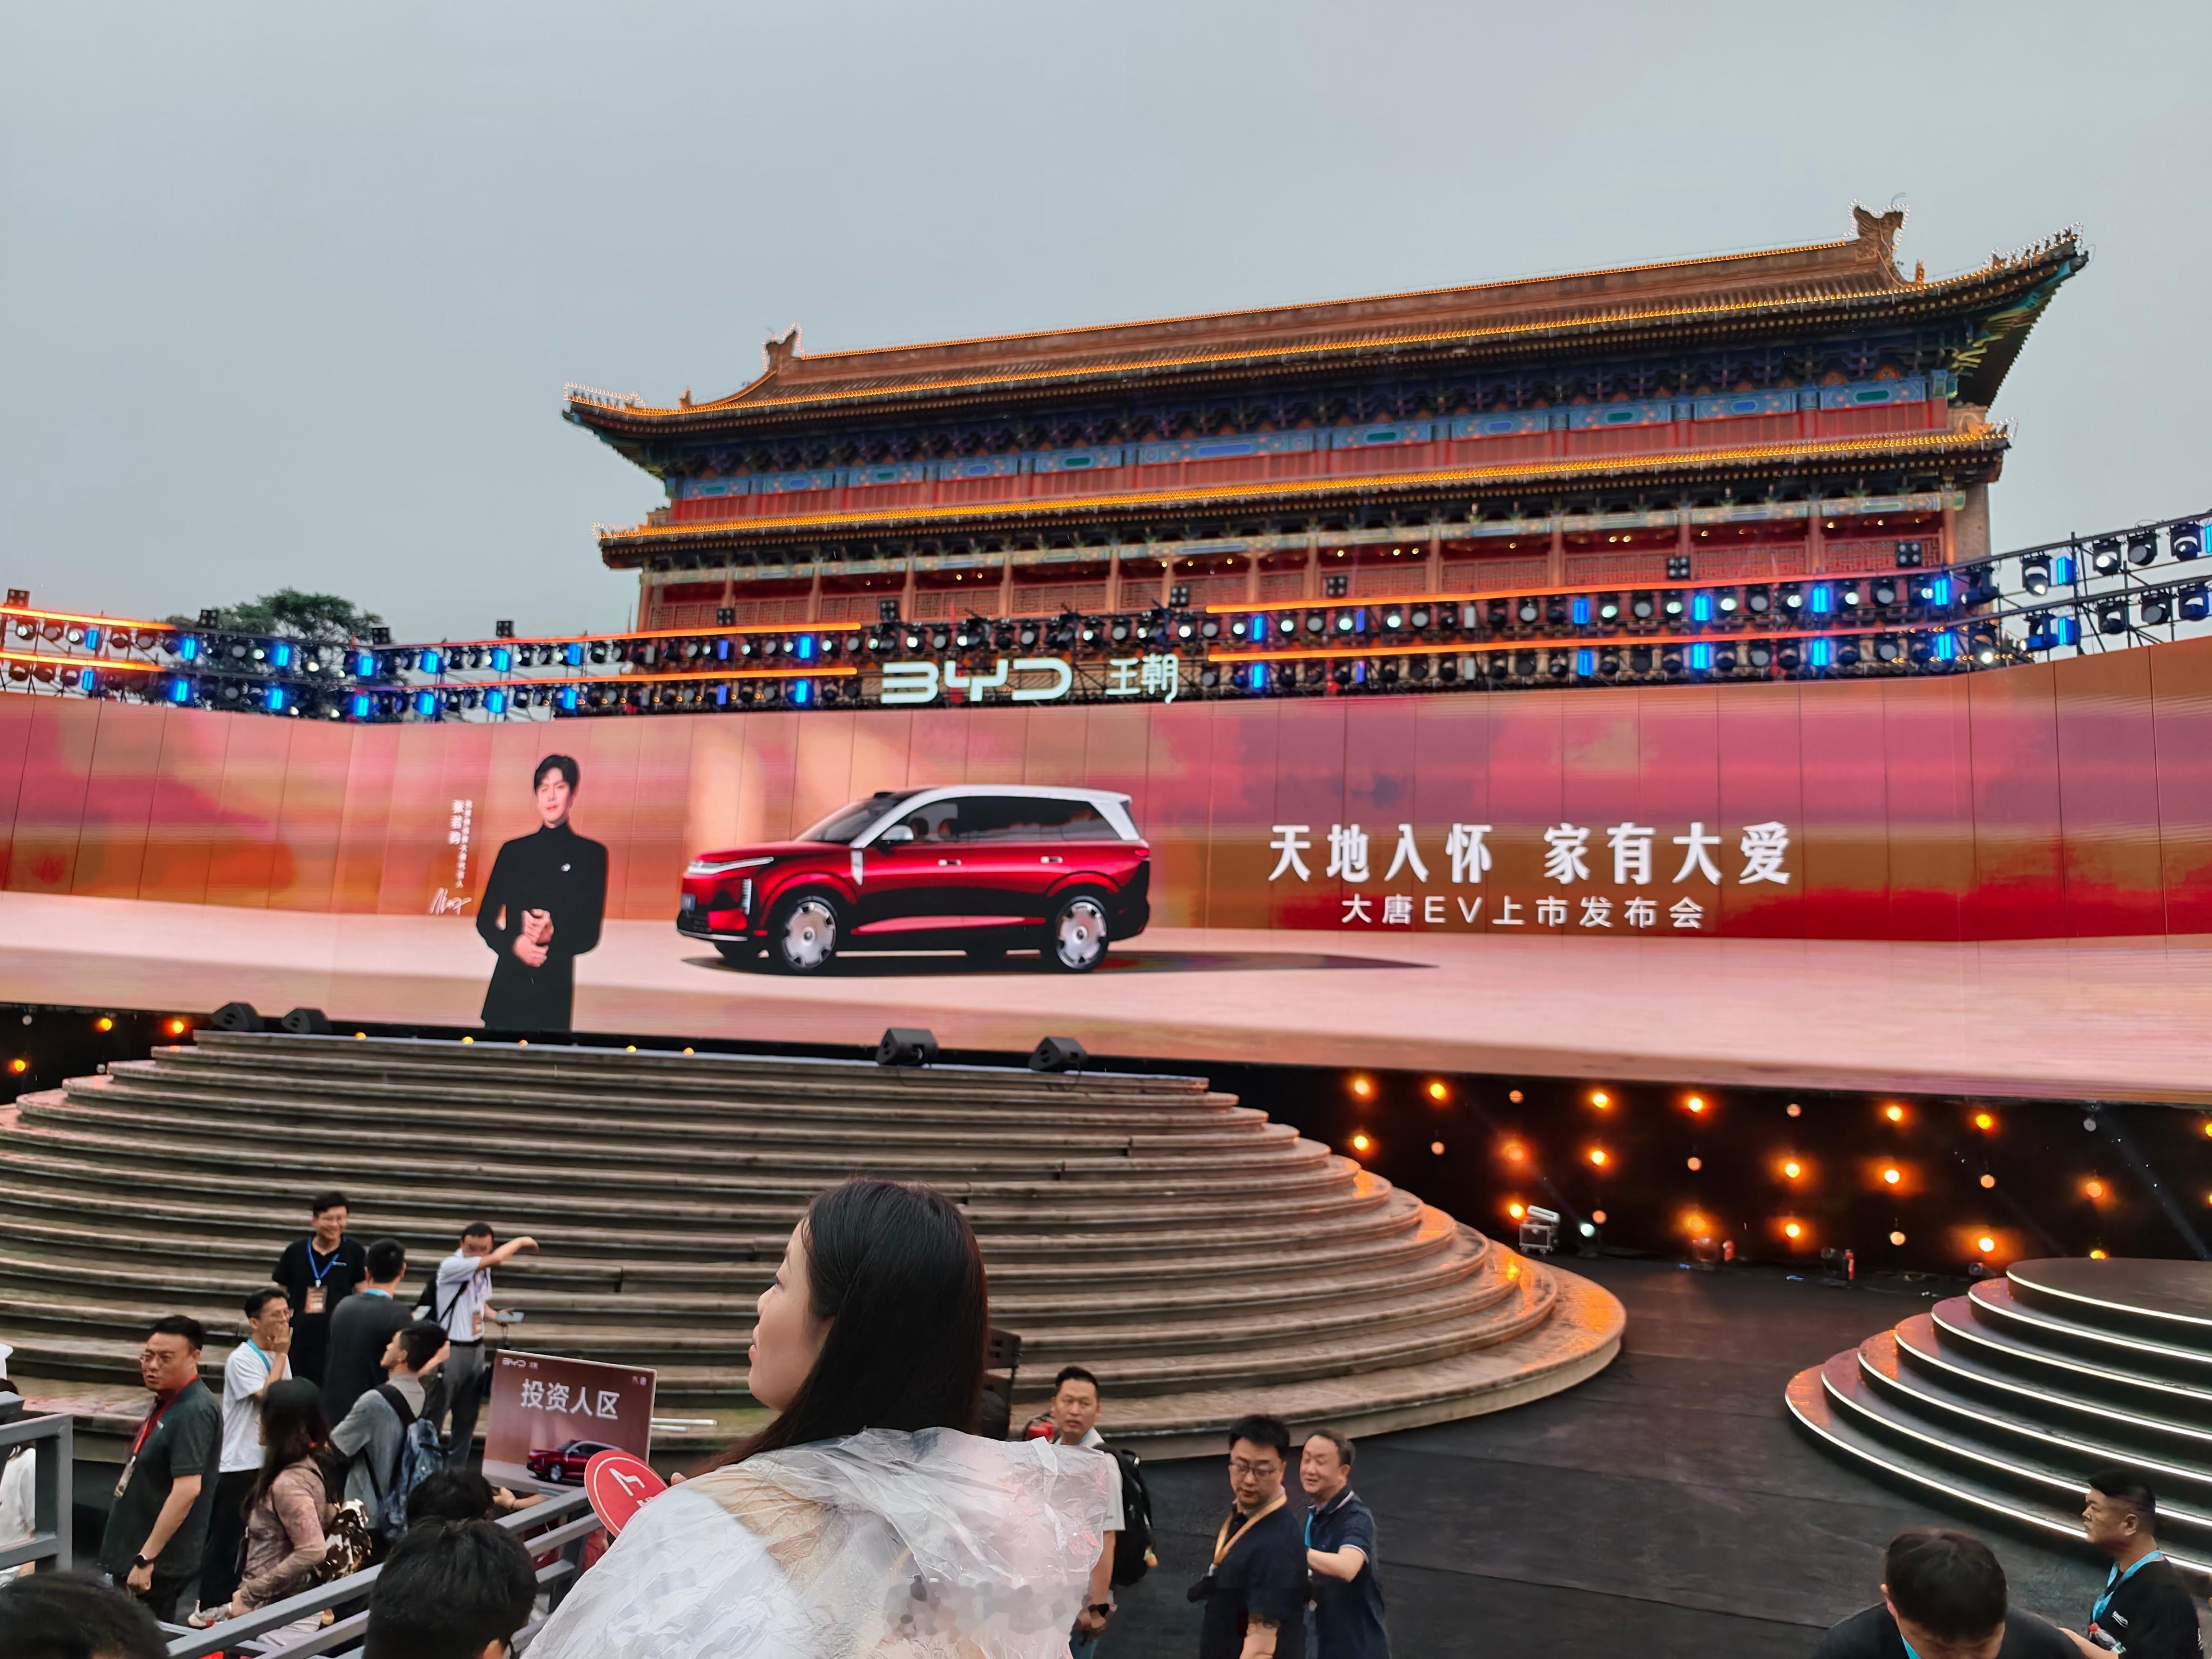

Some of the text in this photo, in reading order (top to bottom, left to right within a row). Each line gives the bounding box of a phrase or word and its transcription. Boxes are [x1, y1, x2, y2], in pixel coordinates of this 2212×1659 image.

[881, 658, 1073, 704] BYD
[1105, 653, 1179, 704] 王朝
[1268, 821, 1790, 885] 天地入怀 家有大爱
[1341, 893, 1703, 928] 大唐EV上市发布会
[520, 1378, 621, 1419] 投资人区
